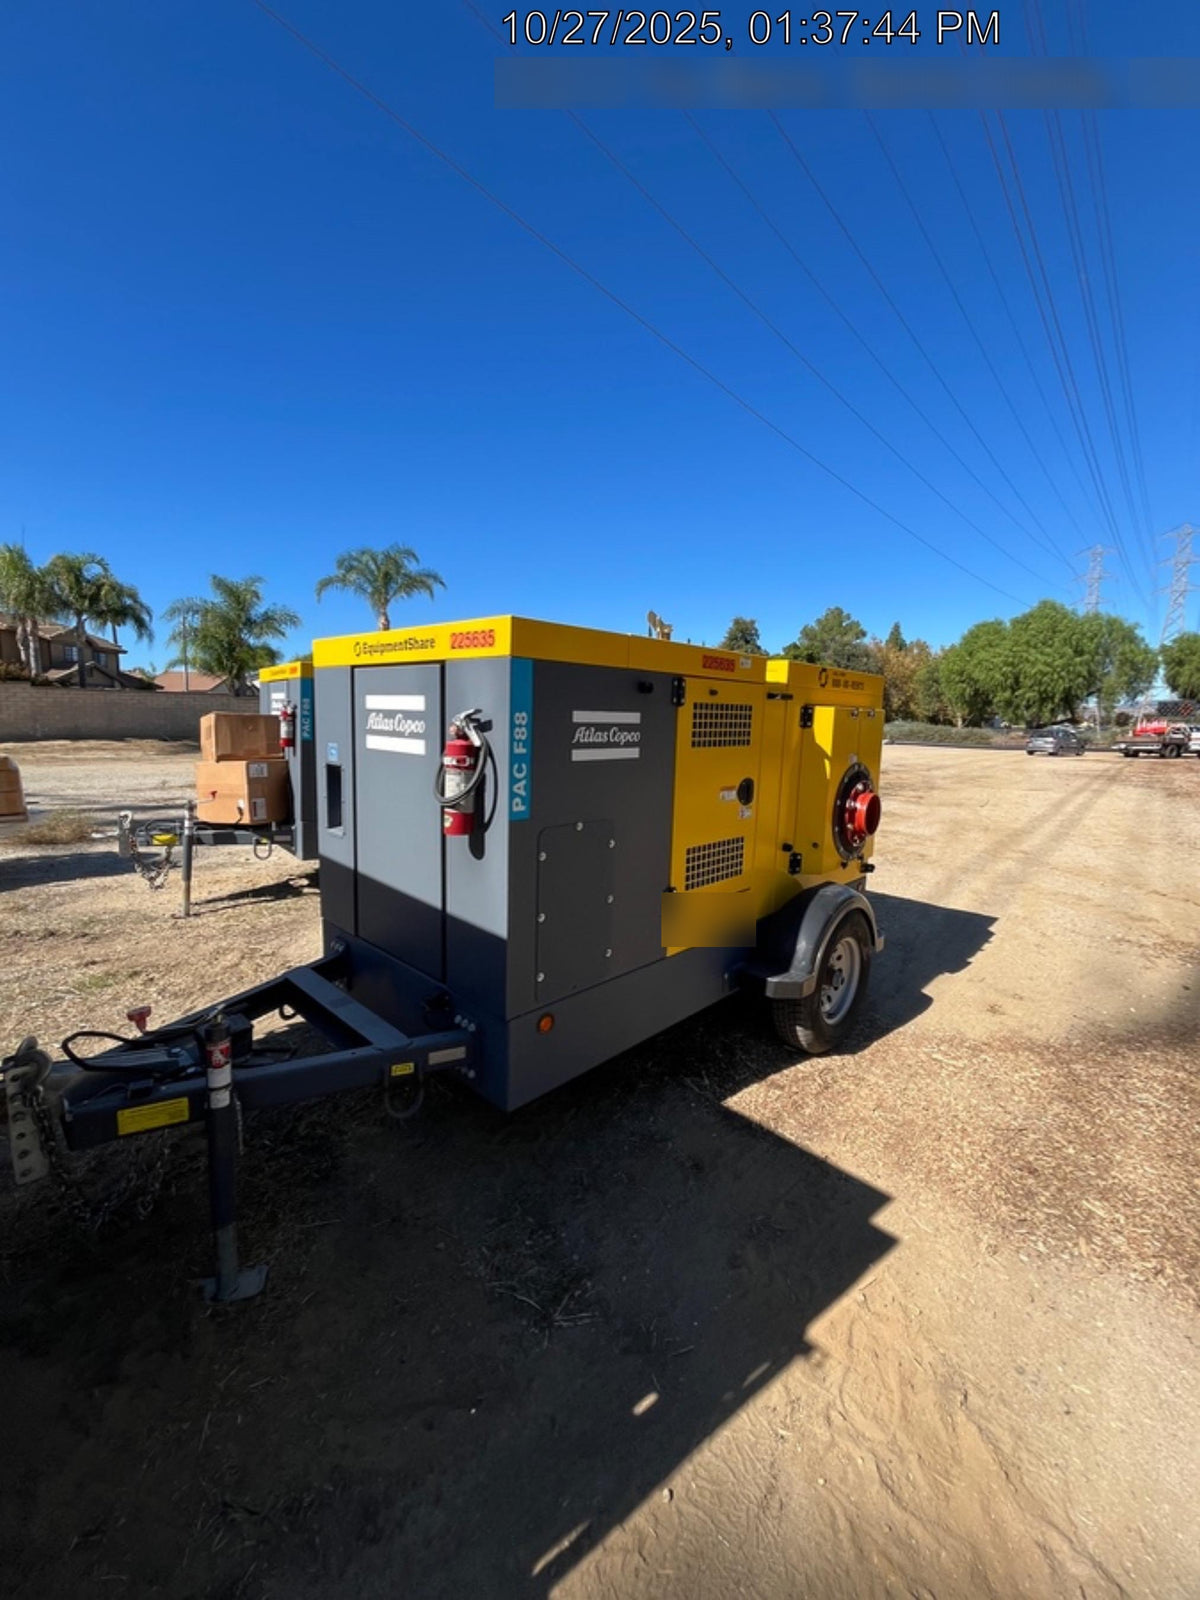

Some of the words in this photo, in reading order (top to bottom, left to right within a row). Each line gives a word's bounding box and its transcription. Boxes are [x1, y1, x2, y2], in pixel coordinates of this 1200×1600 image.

[362, 637, 436, 656] EquipmentShare
[366, 712, 394, 731] Atlas
[394, 713, 426, 737] Copco
[513, 711, 528, 755] F88
[571, 726, 609, 744] Atlas
[609, 726, 641, 746] Copco
[512, 763, 527, 812] PAC
